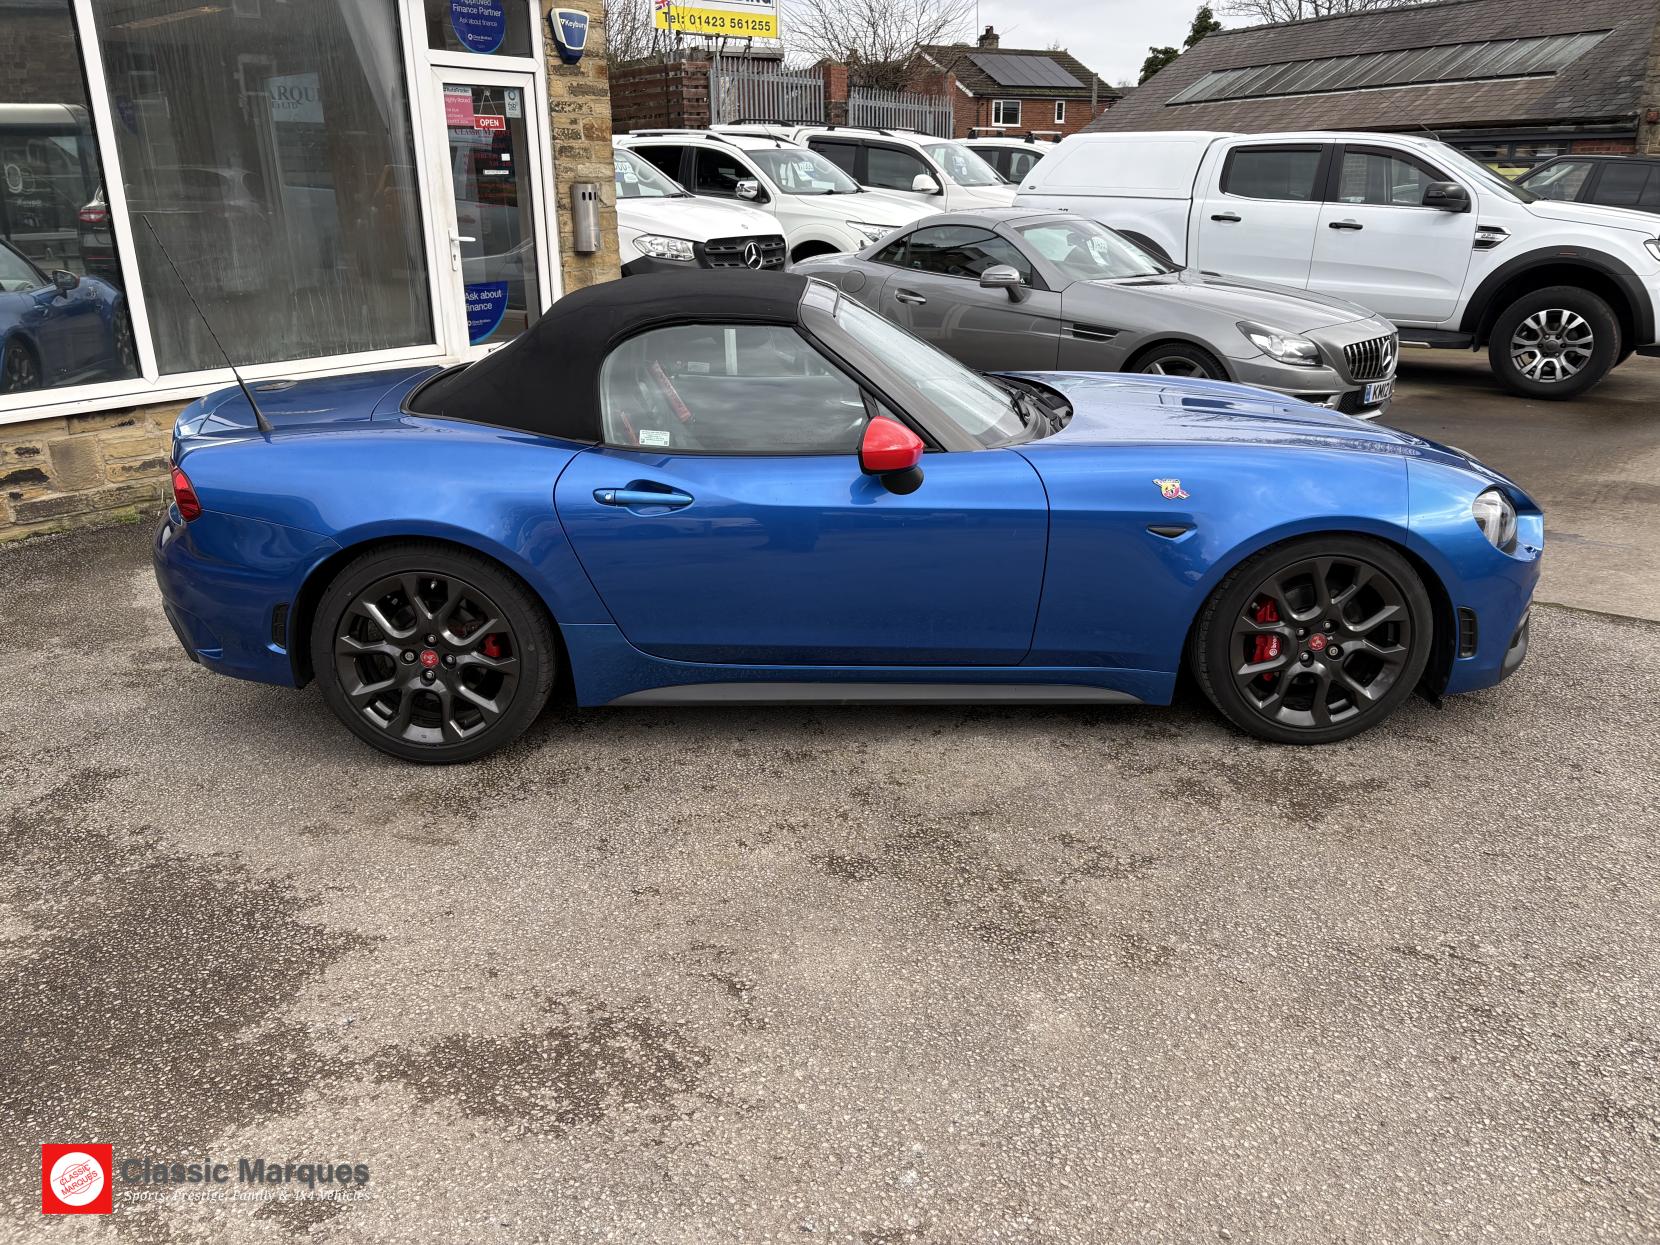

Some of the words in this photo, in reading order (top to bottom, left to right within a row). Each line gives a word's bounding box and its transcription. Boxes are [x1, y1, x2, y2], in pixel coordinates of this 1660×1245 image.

[453, 4, 478, 14] Finance
[479, 7, 501, 17] Partner
[662, 11, 685, 24] Tel:
[689, 14, 725, 28] 01423
[729, 18, 771, 32] 561255
[480, 118, 500, 127] OPEN
[465, 291, 479, 301] Ask
[480, 289, 502, 300] about
